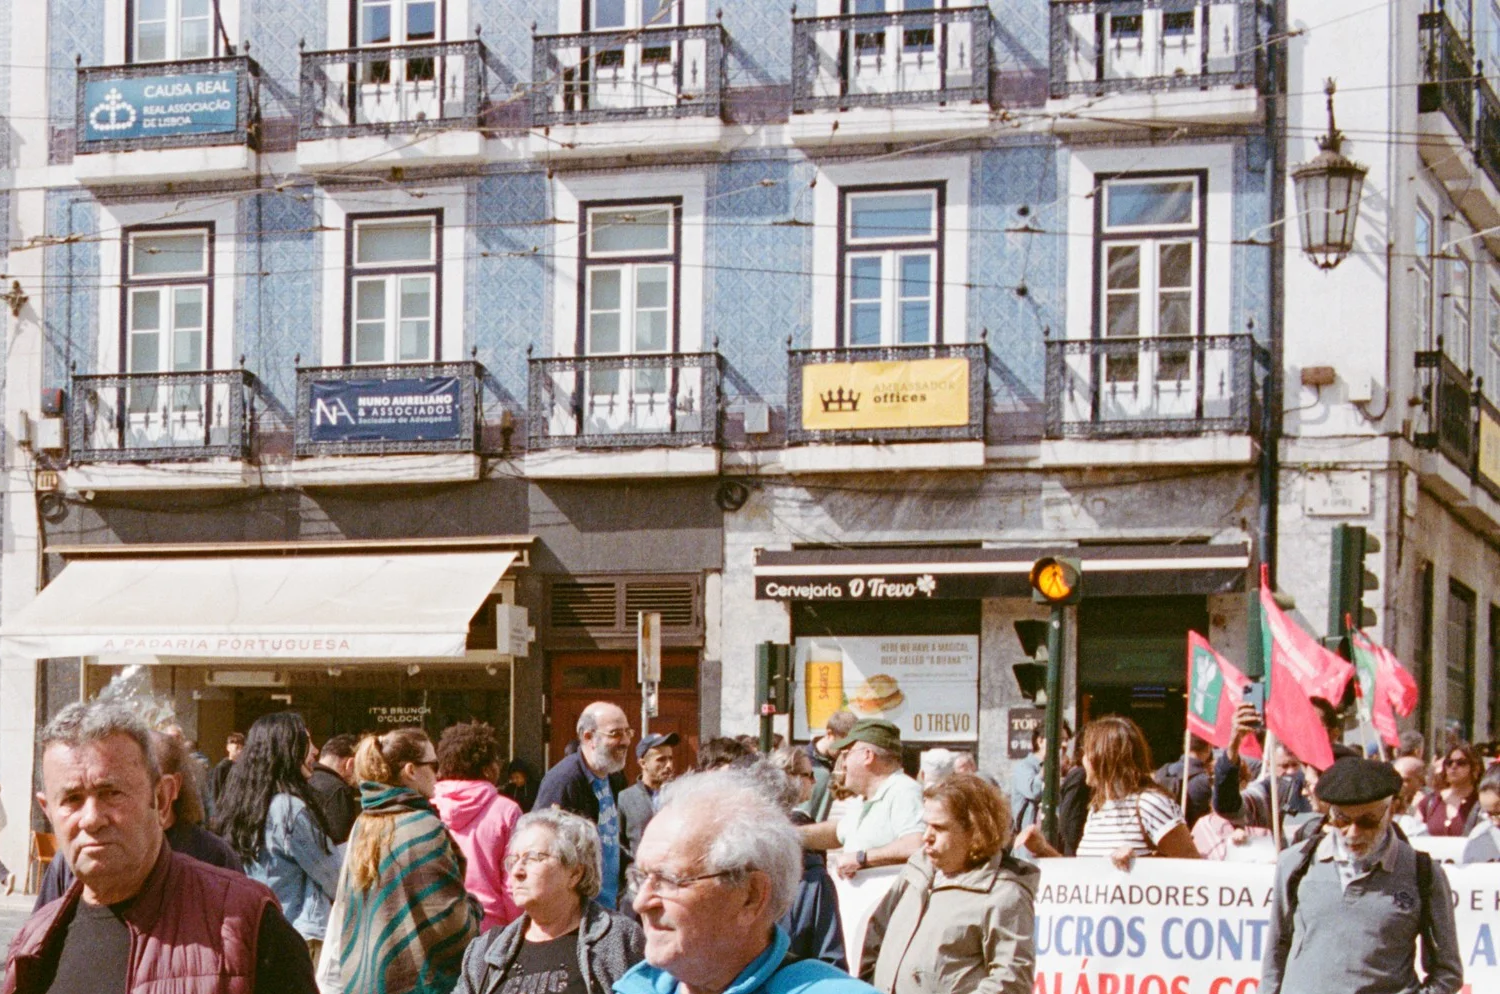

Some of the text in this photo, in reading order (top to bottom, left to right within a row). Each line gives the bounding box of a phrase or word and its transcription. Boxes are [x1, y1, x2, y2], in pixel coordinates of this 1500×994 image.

[144, 80, 231, 98] CAUSA REAL
[143, 99, 231, 115] REAL ASSOCIAÇÃO
[143, 116, 192, 128] DE LISBOA
[358, 394, 453, 407] NUNO AURELIANO
[873, 391, 927, 404] offices
[358, 405, 453, 416] & ASSOCIADOS
[358, 417, 396, 425] Sociedade
[409, 415, 452, 424] Advogados
[765, 578, 916, 599] Cervejaria O Trevo
[104, 638, 350, 650] A PADARIA PORTUGUESA
[818, 665, 830, 700] SAGRES
[369, 706, 432, 715] IT'S BRUNCH
[377, 714, 423, 723] O'CLOCK!
[913, 713, 970, 732] O TREVO
[1218, 887, 1254, 907] DA
